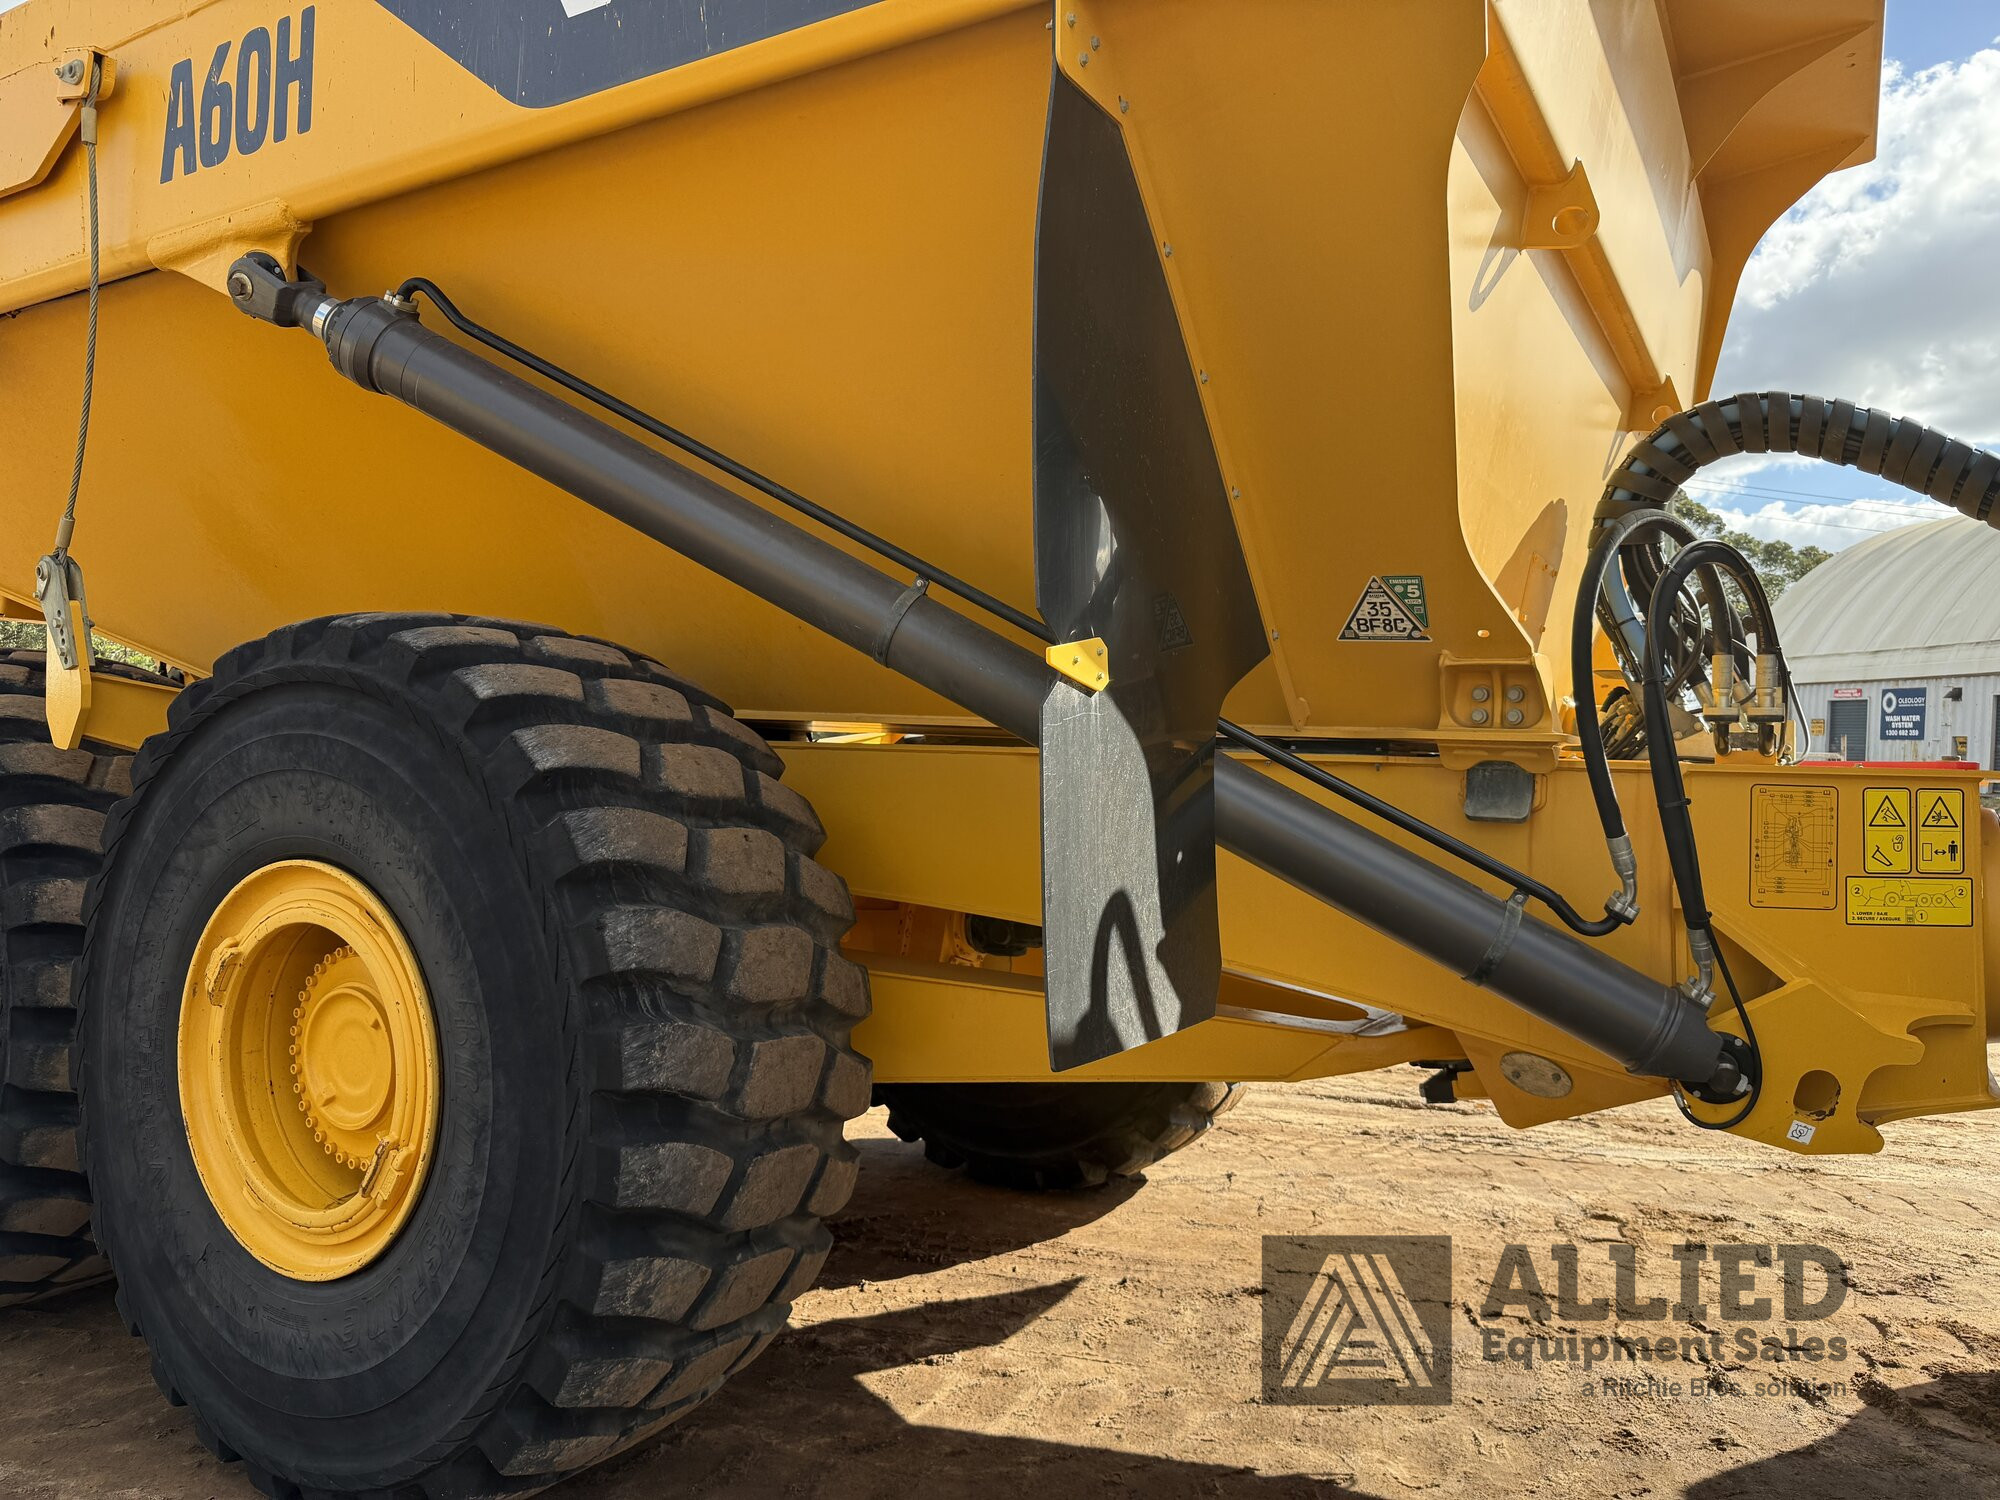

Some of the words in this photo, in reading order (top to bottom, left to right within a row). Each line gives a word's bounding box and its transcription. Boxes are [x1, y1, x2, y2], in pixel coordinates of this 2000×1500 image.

[160, 5, 315, 184] A60H
[1407, 585, 1420, 598] 5
[1366, 602, 1391, 616] 35
[1356, 618, 1407, 633] BF8C
